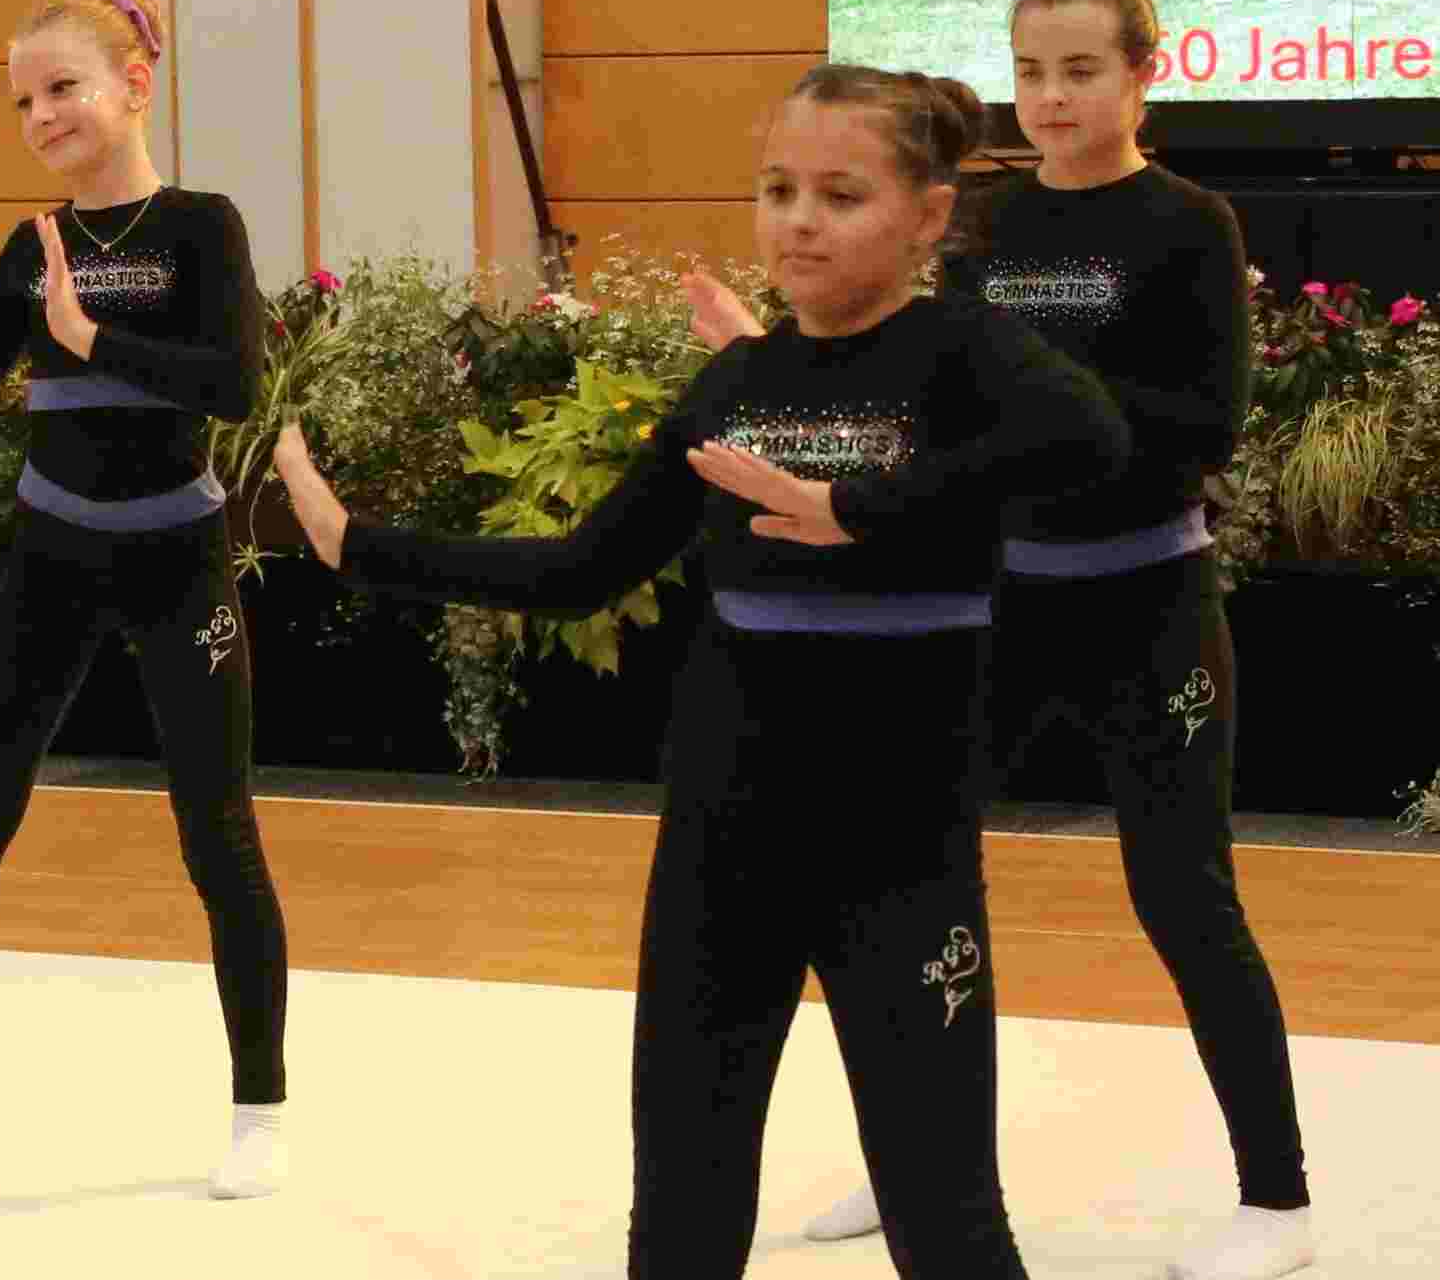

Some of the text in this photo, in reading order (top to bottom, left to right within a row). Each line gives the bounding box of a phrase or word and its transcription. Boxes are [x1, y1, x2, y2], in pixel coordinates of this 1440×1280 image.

[1238, 25, 1433, 82] Jahre
[73, 271, 160, 289] NASTICS
[989, 284, 1107, 303] GYMNASTICS
